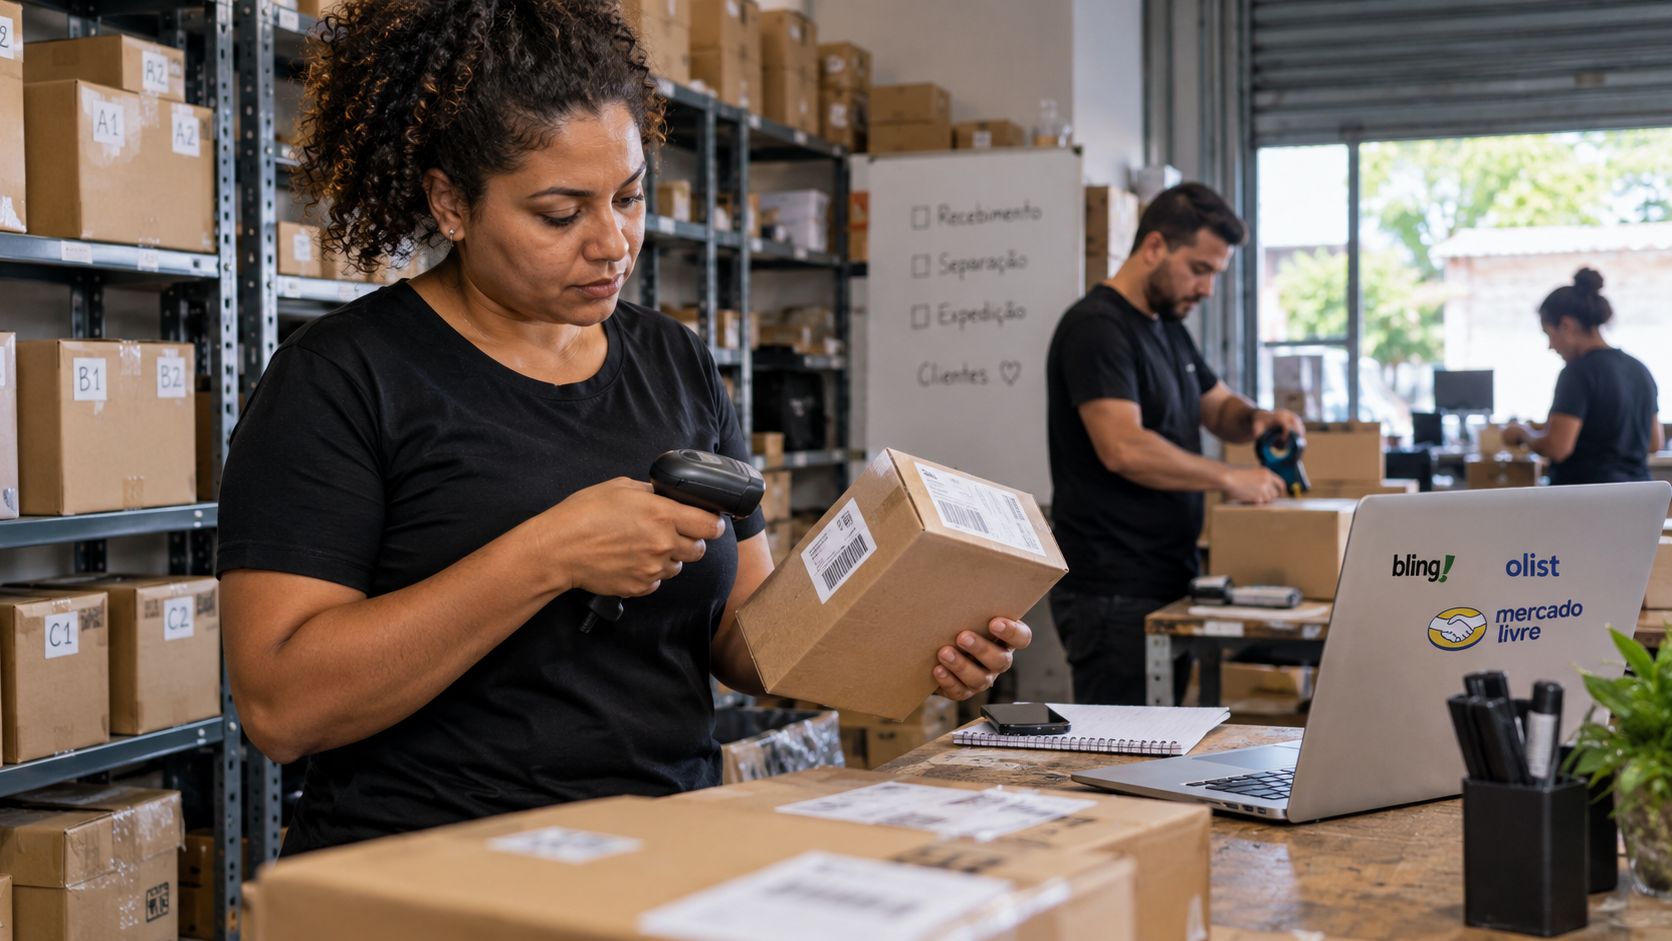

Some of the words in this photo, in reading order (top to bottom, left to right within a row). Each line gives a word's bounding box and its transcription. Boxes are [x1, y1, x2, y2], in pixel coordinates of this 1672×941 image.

[97, 109, 119, 136] A1
[175, 121, 195, 147] A2
[938, 199, 1043, 227] Recebimento
[938, 250, 1029, 281] Separação
[938, 300, 1027, 331] Expedição
[79, 366, 101, 392] B1
[160, 365, 182, 389] B2
[917, 361, 989, 387] Clientes
[1392, 554, 1456, 583] bling!
[1505, 553, 1560, 577] olist
[167, 606, 190, 630] C2
[1495, 599, 1583, 623] mercado
[49, 621, 72, 647] C1
[1497, 624, 1541, 643] livre
